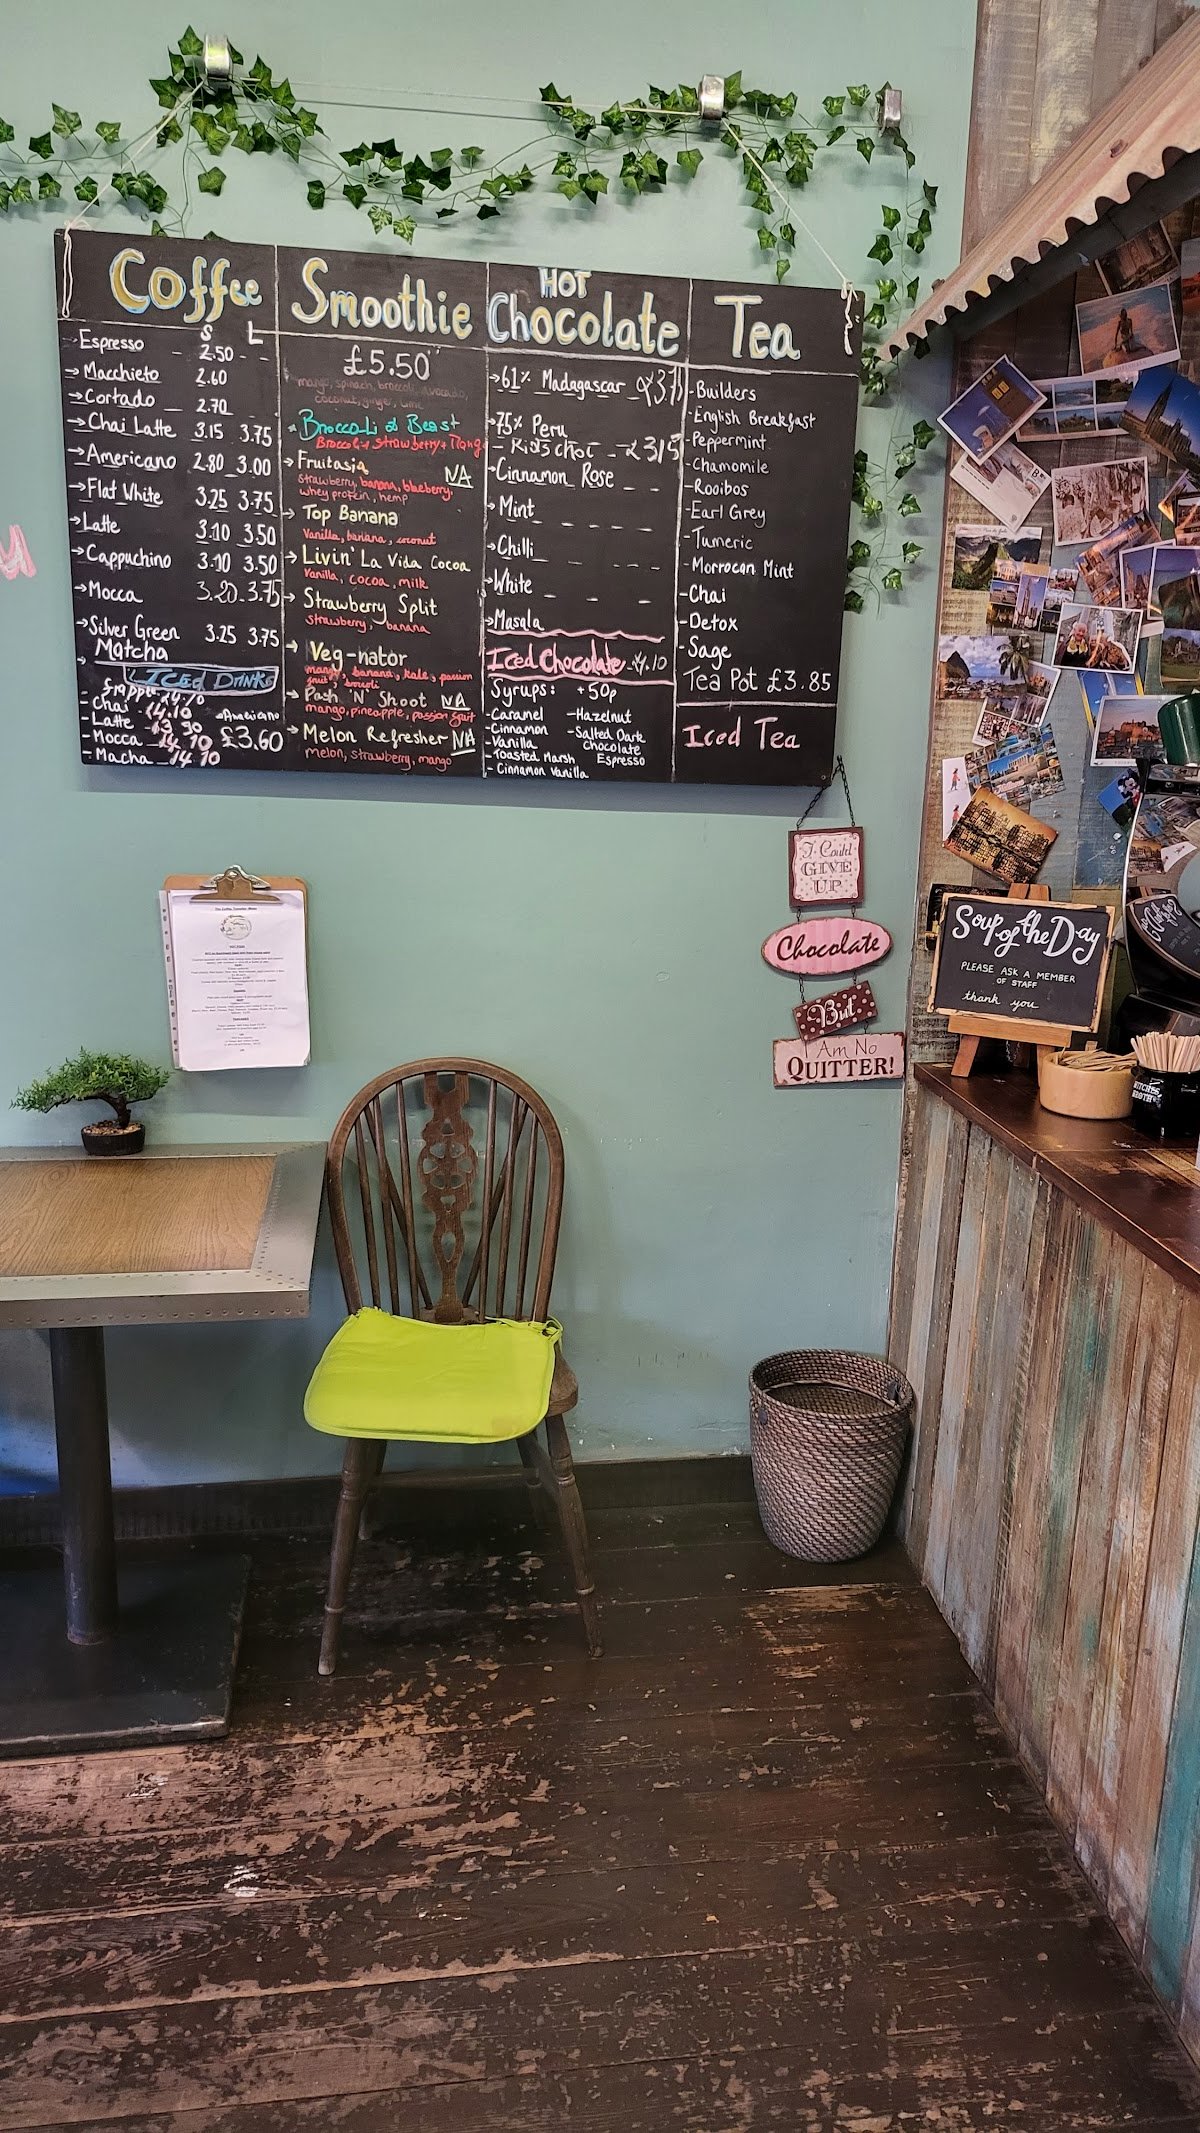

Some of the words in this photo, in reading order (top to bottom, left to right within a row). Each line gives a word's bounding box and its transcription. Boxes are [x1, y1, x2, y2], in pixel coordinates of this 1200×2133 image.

[109, 248, 263, 323] Coffee
[538, 267, 592, 298] HOT
[291, 257, 473, 340] Smoothie
[200, 324, 213, 342] S
[247, 320, 264, 345] L
[488, 291, 680, 357] Chocolate
[713, 295, 800, 360] Tea
[79, 329, 145, 354] Espresso
[199, 344, 234, 361] 2.50
[84, 361, 159, 382] Macchieto
[196, 368, 228, 385] 2.60
[343, 344, 430, 381] £5.50
[502, 366, 531, 389] 61%
[542, 369, 626, 400] Madagascar
[696, 380, 756, 401] Builders
[85, 388, 155, 407] Cortado
[196, 399, 228, 413] 2.70
[88, 412, 126, 433] Chai
[134, 416, 177, 438] Latte
[194, 423, 223, 440] 3.15
[240, 424, 272, 447] 3.75
[496, 412, 522, 436] 75%
[532, 414, 569, 438] Peru
[694, 406, 741, 434] English
[750, 410, 816, 432] Breakfast
[692, 432, 767, 453] Peppermint
[87, 443, 177, 470] Americano
[193, 452, 224, 471] 2.80
[236, 457, 271, 476] 3.00
[298, 450, 369, 475] Fruitasia
[692, 457, 769, 474] Chamomile
[496, 457, 568, 485] Cinnamon
[582, 462, 614, 488] Rose
[87, 477, 117, 499] Flat
[123, 482, 164, 505] White
[196, 486, 227, 510] 3.25
[238, 490, 273, 513] 3.75
[694, 478, 749, 496] Rooibos
[303, 504, 331, 526] Top
[339, 505, 399, 526] Banana
[500, 495, 535, 519] Mint
[691, 500, 723, 519] Earl
[729, 504, 766, 528] Grey
[83, 511, 121, 533] Latte
[195, 519, 230, 541] 3.10
[244, 523, 276, 546] 3.50
[396, 533, 437, 545] coconut
[692, 526, 753, 549] Tumeric
[497, 535, 534, 558] Chilli
[87, 544, 171, 570] Cappuchino
[197, 553, 231, 573] 3.10
[243, 555, 278, 575] 3.50
[361, 549, 382, 569] La
[388, 553, 422, 570] Vida
[431, 556, 471, 572] Cocoa
[692, 556, 755, 575] Morrocan
[763, 559, 794, 579] Mint
[399, 578, 428, 589] milk
[494, 568, 532, 594] White
[89, 580, 143, 602] Mocca
[197, 580, 238, 603] 3.20
[248, 579, 282, 607] 3.75
[689, 584, 726, 604] Chai
[304, 587, 387, 624] Strawberry
[398, 594, 438, 622] Split
[89, 615, 128, 637] Silver
[135, 614, 180, 640] Green
[205, 624, 237, 644] 3.25
[248, 627, 279, 647] 3.75
[386, 621, 431, 634] banana
[494, 608, 544, 631] Masala
[689, 612, 738, 631] Detox
[95, 638, 168, 661] Matcha
[309, 641, 408, 671] Veg-nator
[486, 643, 539, 671] Iced
[540, 639, 626, 676] Chocolate
[688, 635, 732, 670] Sage
[683, 666, 721, 692] Tea
[731, 667, 758, 692] Pot
[767, 668, 831, 692] £3.85
[92, 695, 129, 713] Chai
[305, 687, 339, 703] Pash
[378, 691, 427, 708] Shoot
[491, 679, 555, 707] Syrups:
[91, 711, 134, 729] Latte
[491, 707, 544, 721] Caramel
[575, 707, 632, 724] Hazelnut
[93, 729, 143, 746] Mocca
[221, 726, 283, 752] £3.60
[303, 723, 357, 744] Melon
[367, 726, 448, 748] Refresher
[491, 724, 548, 735] Cinnamon
[575, 727, 614, 740] Salted
[617, 729, 646, 743] Dark
[682, 716, 741, 748] Iced
[754, 717, 800, 751] Tea
[492, 737, 538, 749] Vanilla
[583, 741, 641, 755] Chocolate
[96, 747, 153, 765] Macha
[418, 755, 452, 772] mango
[493, 750, 540, 763] Toasted
[544, 752, 575, 764] Marsh
[597, 754, 645, 768] Espresso
[497, 764, 546, 775] Cinnamon
[551, 767, 589, 779] Vanilla
[820, 840, 852, 858] Could
[801, 861, 852, 876] GIVE
[813, 879, 842, 894] UP
[777, 930, 880, 961] Chocolate
[952, 904, 1004, 946] Soup
[995, 925, 1020, 958] of
[1016, 909, 1050, 945] the
[1043, 915, 1100, 965] Day
[961, 961, 994, 974] PLEASE
[1000, 966, 1018, 976] ASK
[1023, 970, 1030, 978] A
[1036, 972, 1076, 983] MEMBER
[1012, 980, 1037, 988] STAFF
[807, 997, 857, 1028] But
[962, 990, 1000, 1005] thank
[1010, 999, 1039, 1012] you
[816, 1040, 849, 1058] Am
[855, 1038, 877, 1055] No
[788, 1057, 894, 1081] QUITTER!
